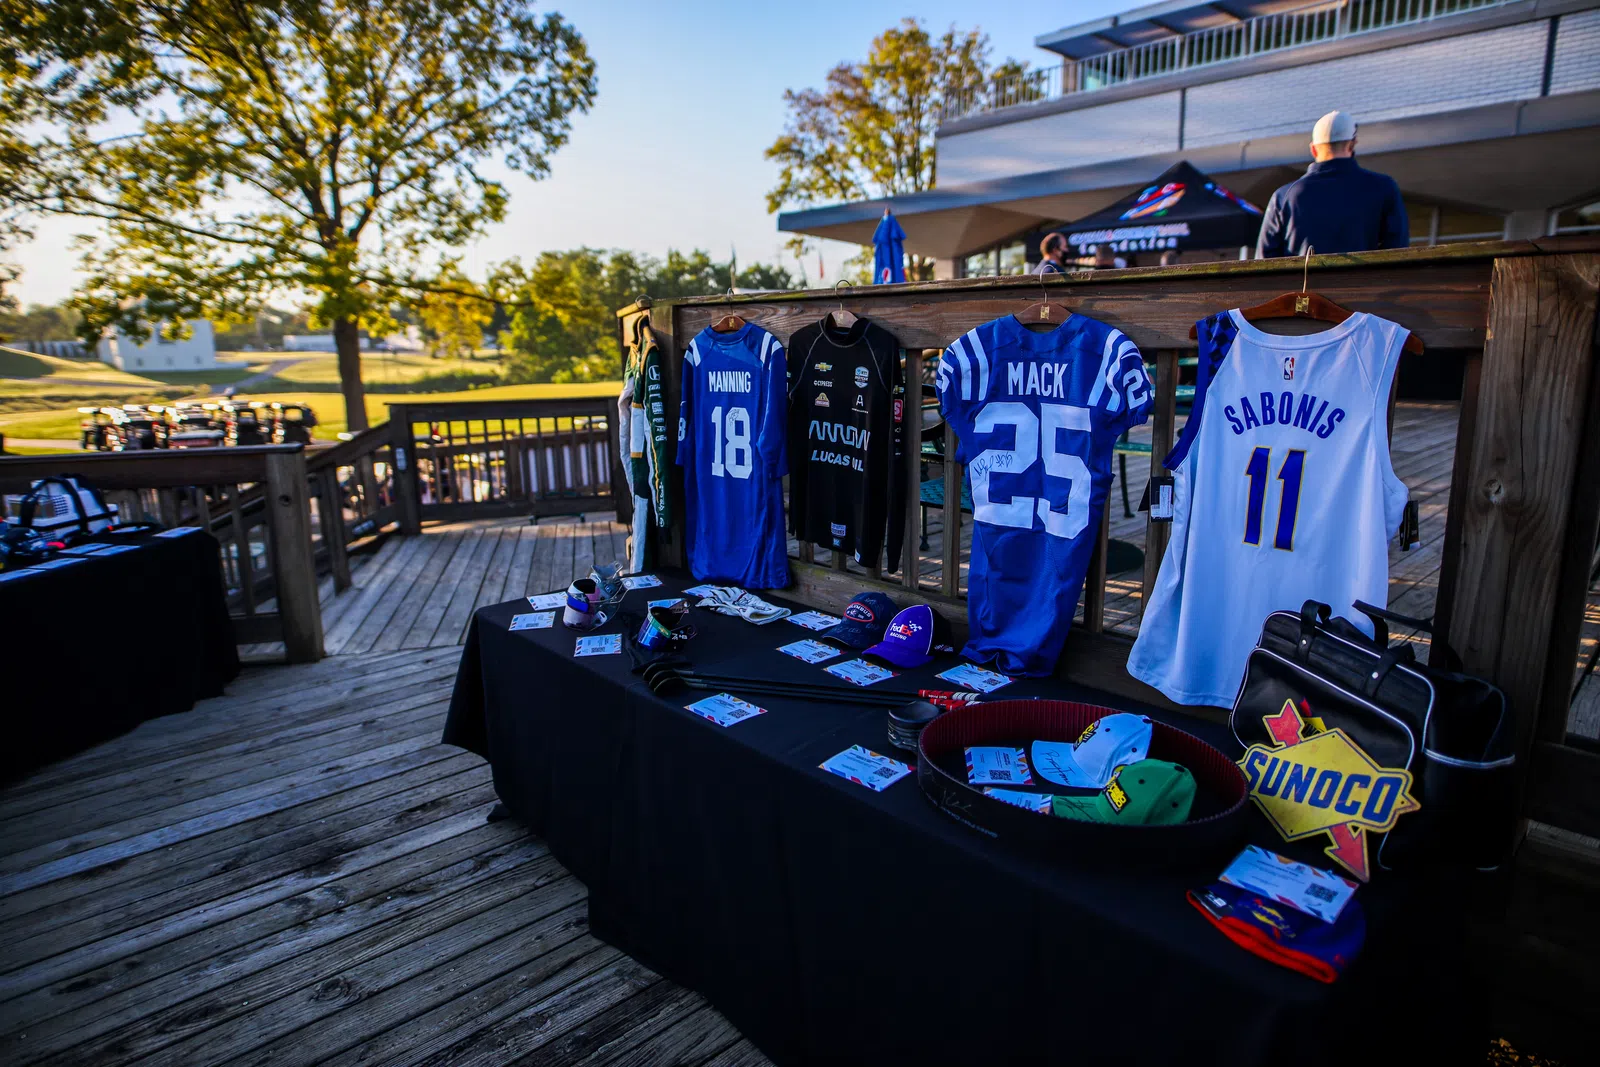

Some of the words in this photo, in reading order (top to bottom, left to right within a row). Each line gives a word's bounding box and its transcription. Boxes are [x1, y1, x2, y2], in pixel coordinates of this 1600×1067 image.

[708, 371, 751, 393] MANNING
[1007, 362, 1068, 398] MACK
[1223, 391, 1346, 440] SABONIS
[711, 406, 753, 480] 18
[811, 449, 851, 467] LUCAS
[969, 401, 1092, 540] 25
[1242, 445, 1308, 553] 11
[889, 622, 913, 637] FedEx
[1247, 750, 1404, 824] SUNOCO
